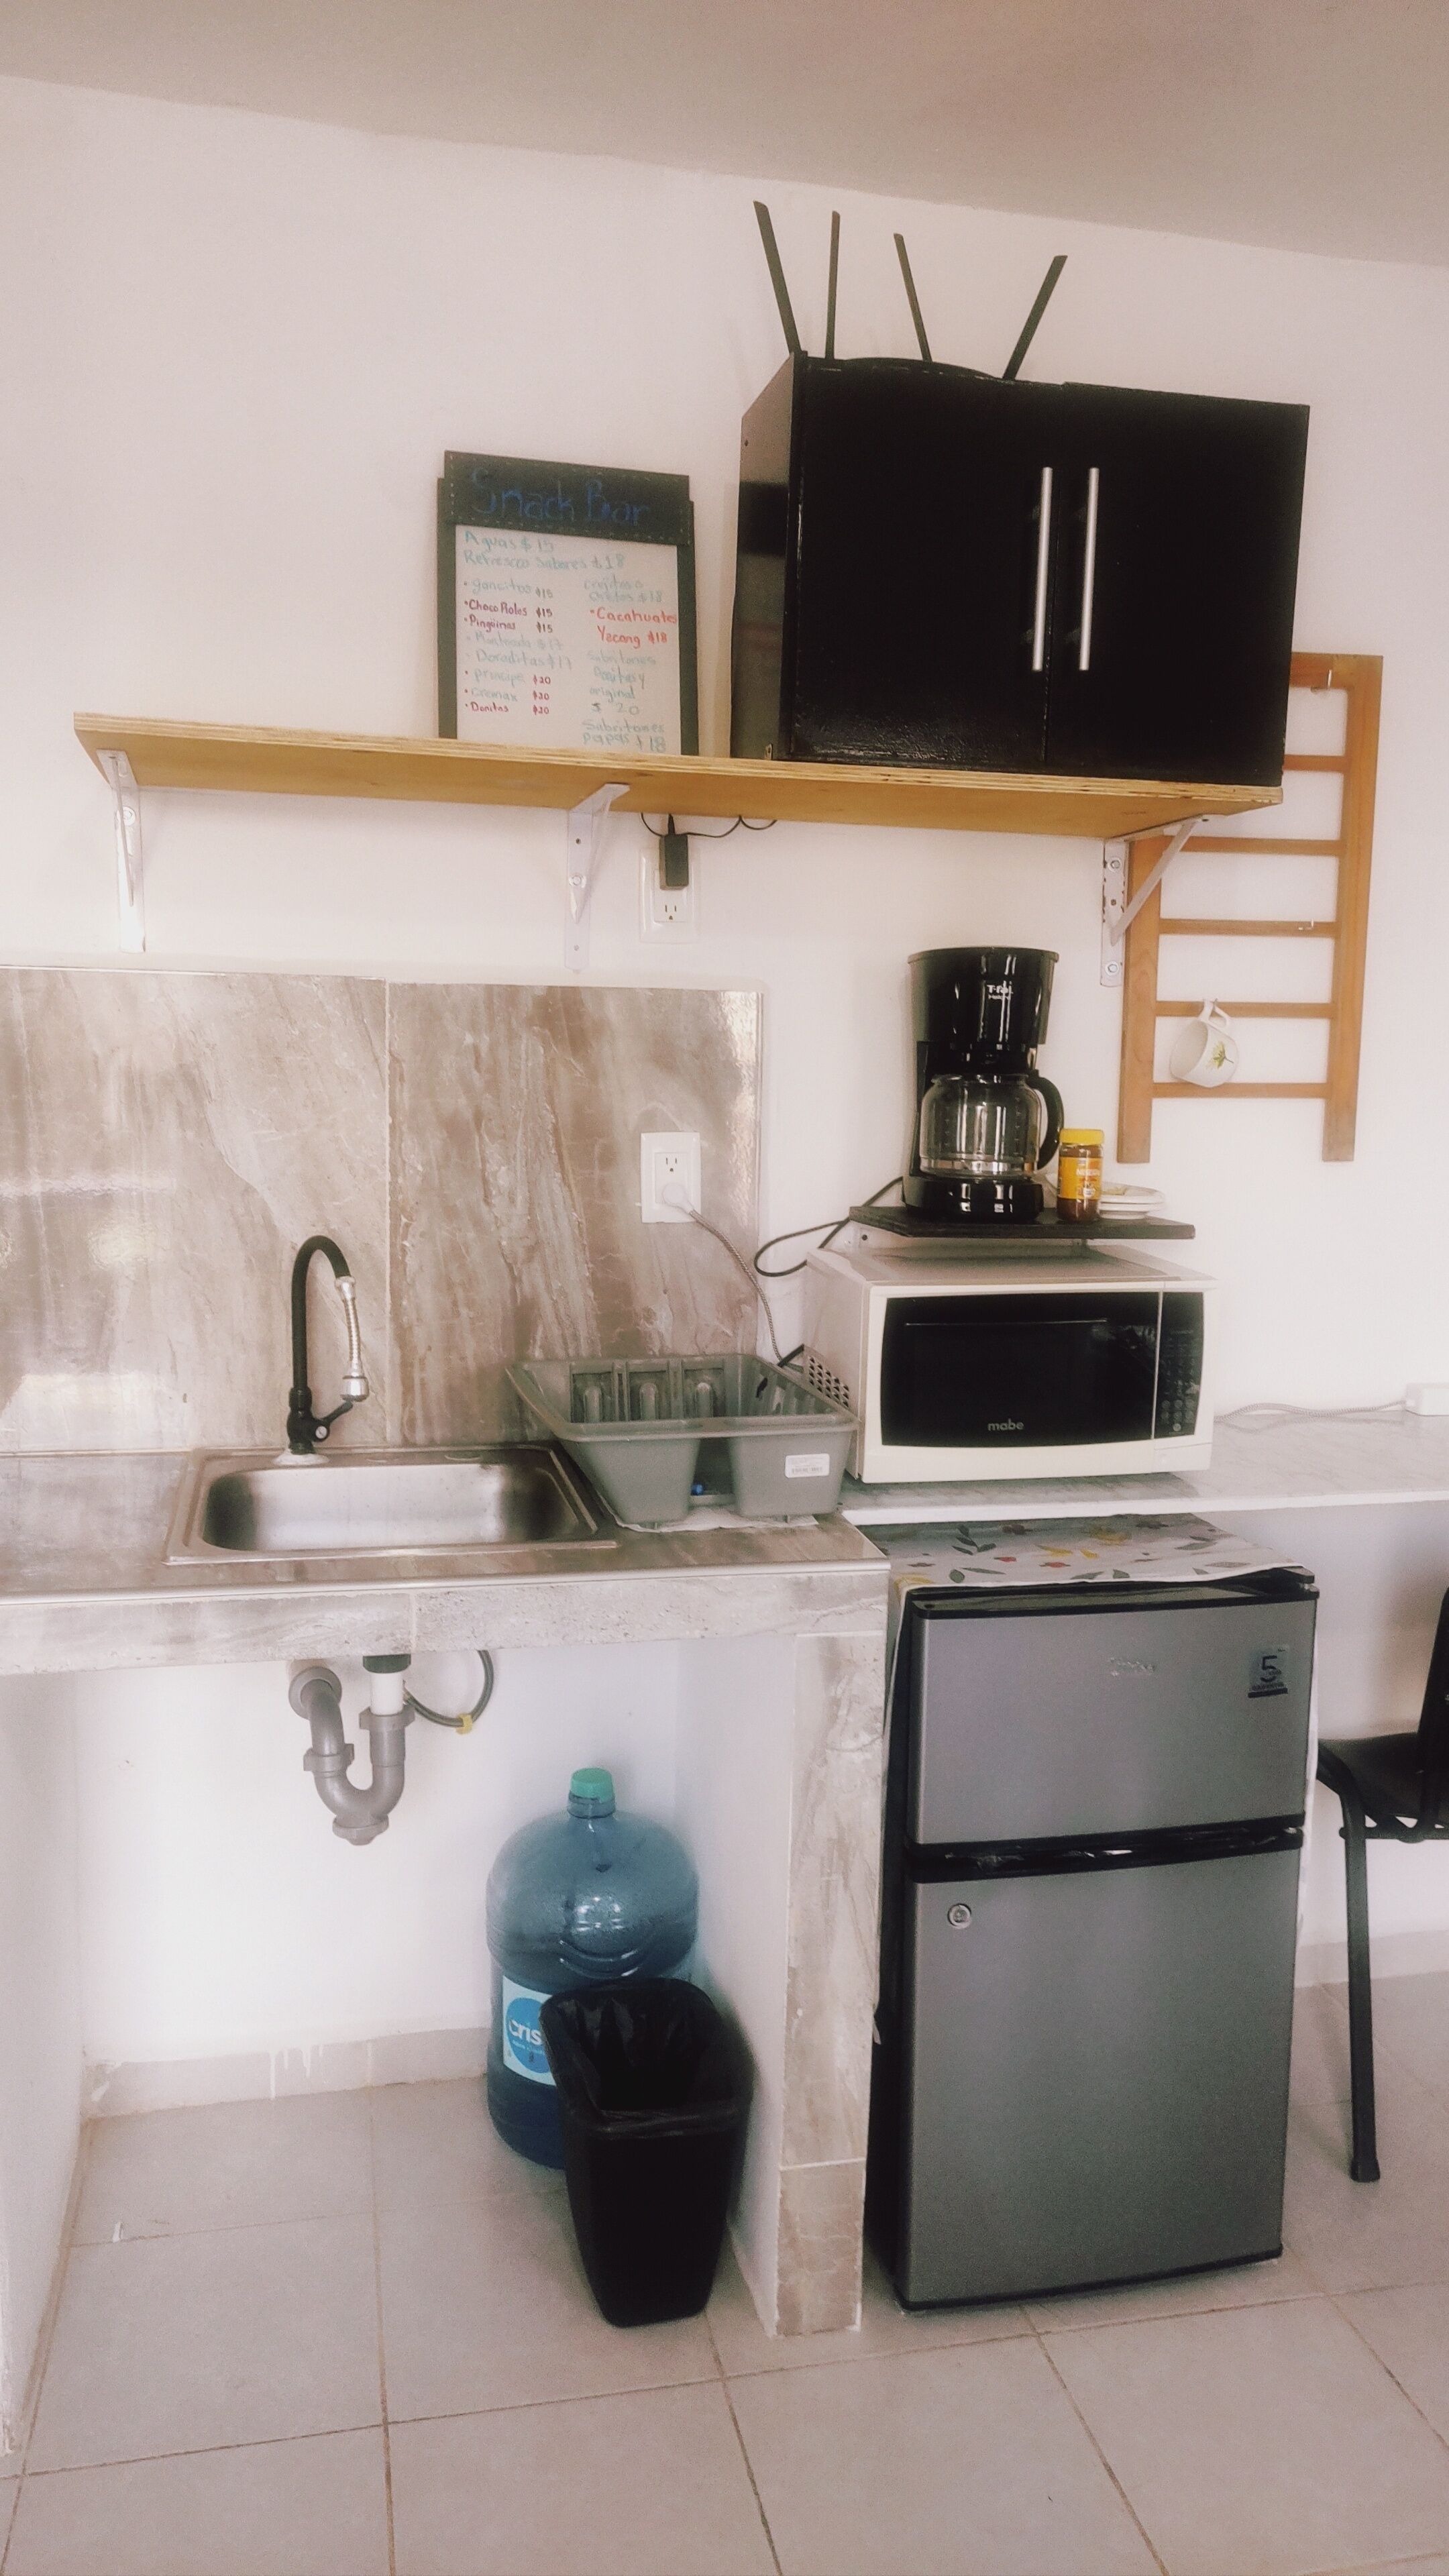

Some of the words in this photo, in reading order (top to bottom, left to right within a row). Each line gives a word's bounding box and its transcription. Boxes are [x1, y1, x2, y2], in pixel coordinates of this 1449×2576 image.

[471, 468, 575, 521] Snack
[586, 479, 650, 527] Bar
[464, 530, 516, 551] Aguas
[536, 606, 553, 619] $15
[536, 621, 553, 634] $15
[533, 674, 551, 686] $20
[533, 690, 550, 701] $20
[533, 704, 550, 716] $20
[987, 1418, 1024, 1431] mabe
[1260, 1655, 1277, 1682] 5
